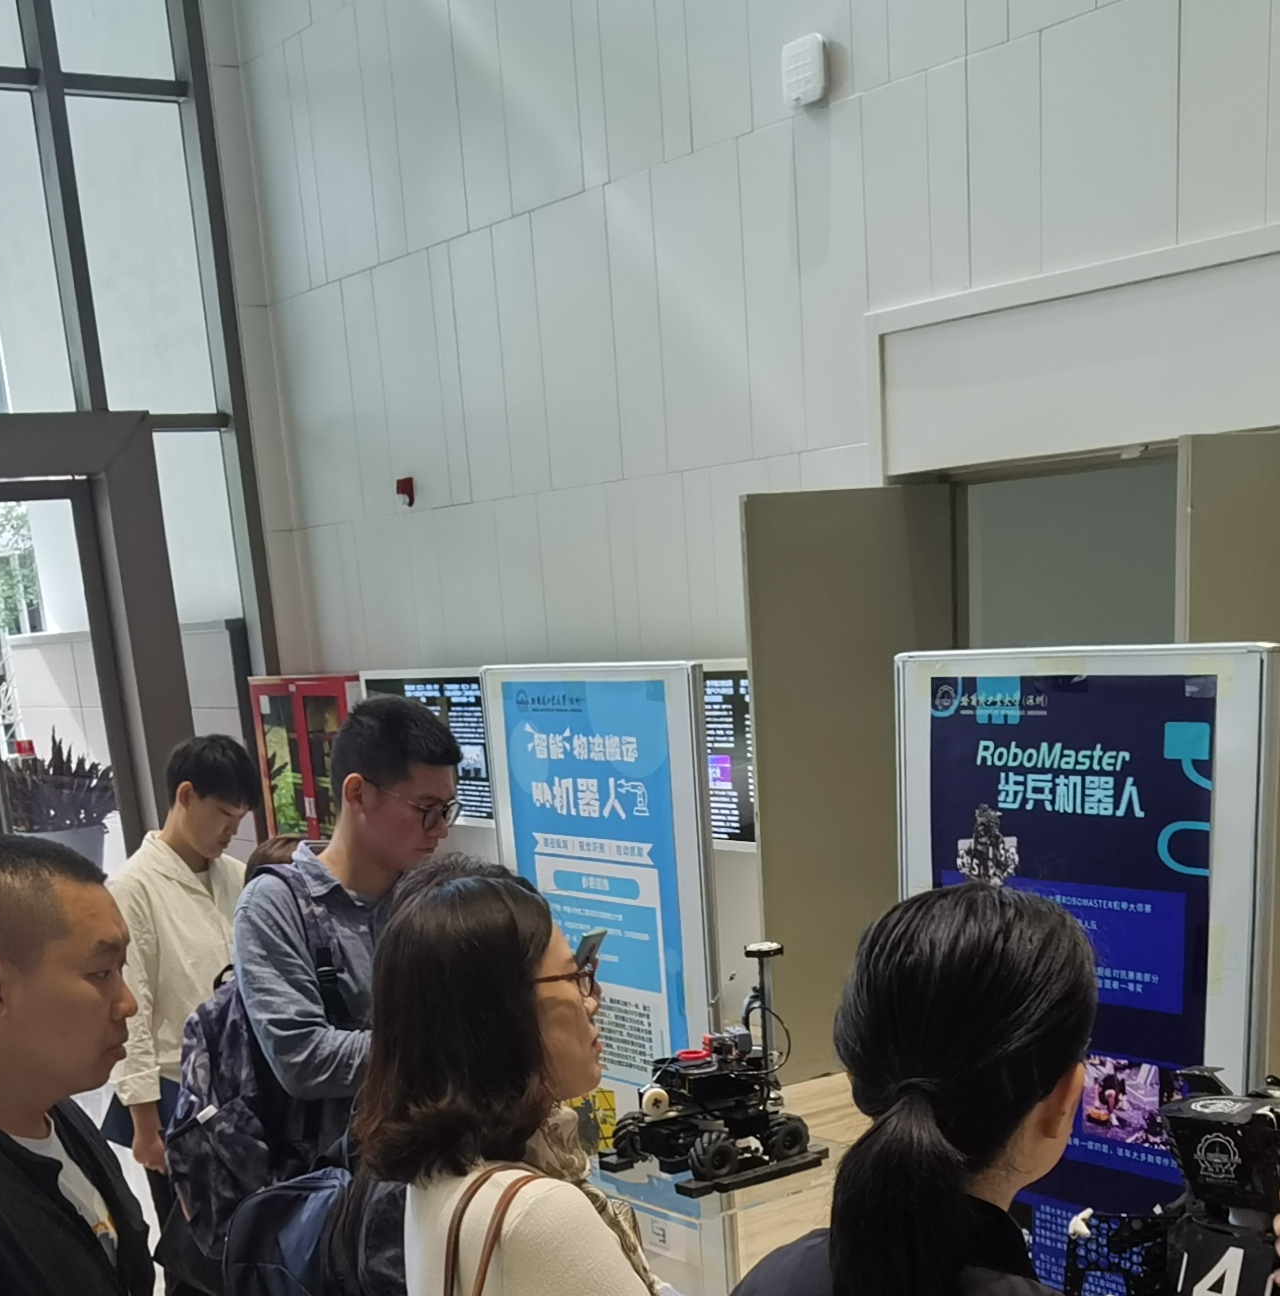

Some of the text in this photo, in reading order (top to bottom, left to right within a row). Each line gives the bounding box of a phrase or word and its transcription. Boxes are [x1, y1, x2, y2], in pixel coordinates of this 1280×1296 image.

[976, 740, 1130, 772] RoboMaster
[553, 776, 627, 820] 机器人
[997, 771, 1146, 818] 步兵机器人
